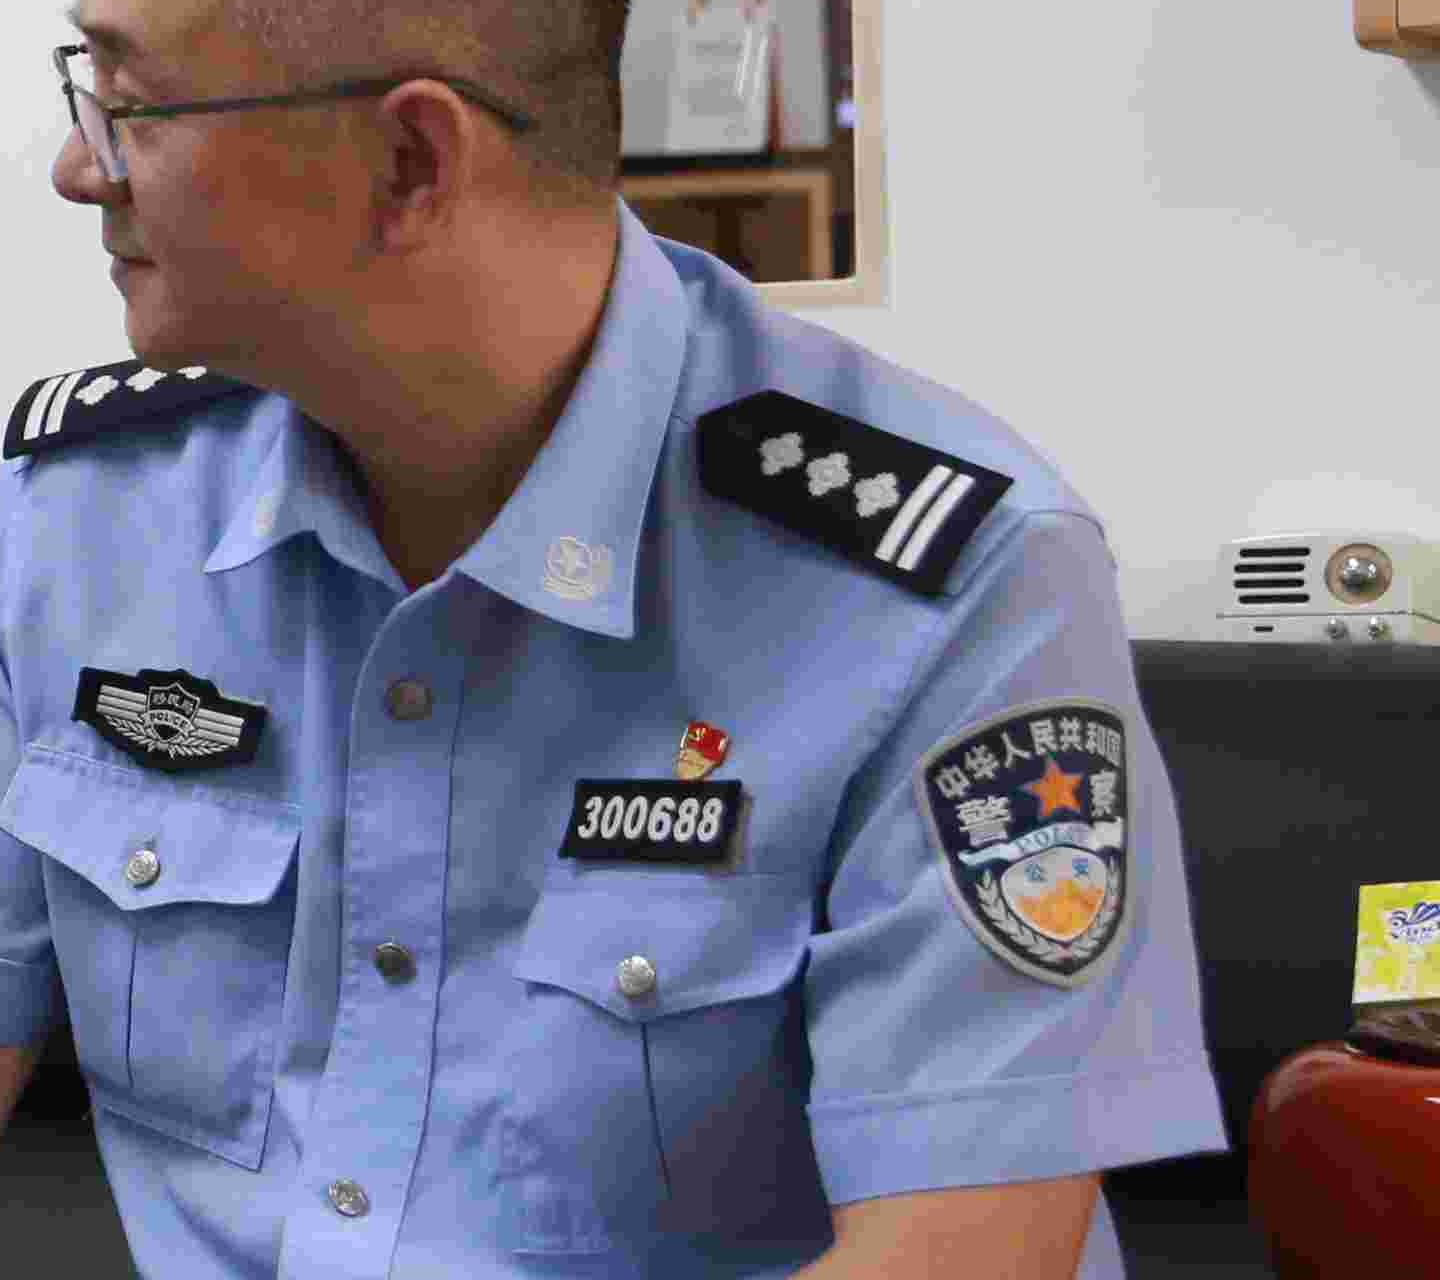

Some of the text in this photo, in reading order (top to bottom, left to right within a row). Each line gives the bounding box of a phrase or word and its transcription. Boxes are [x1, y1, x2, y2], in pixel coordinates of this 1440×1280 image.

[934, 717, 1121, 800] 中华人民共和国
[577, 794, 723, 843] 300688
